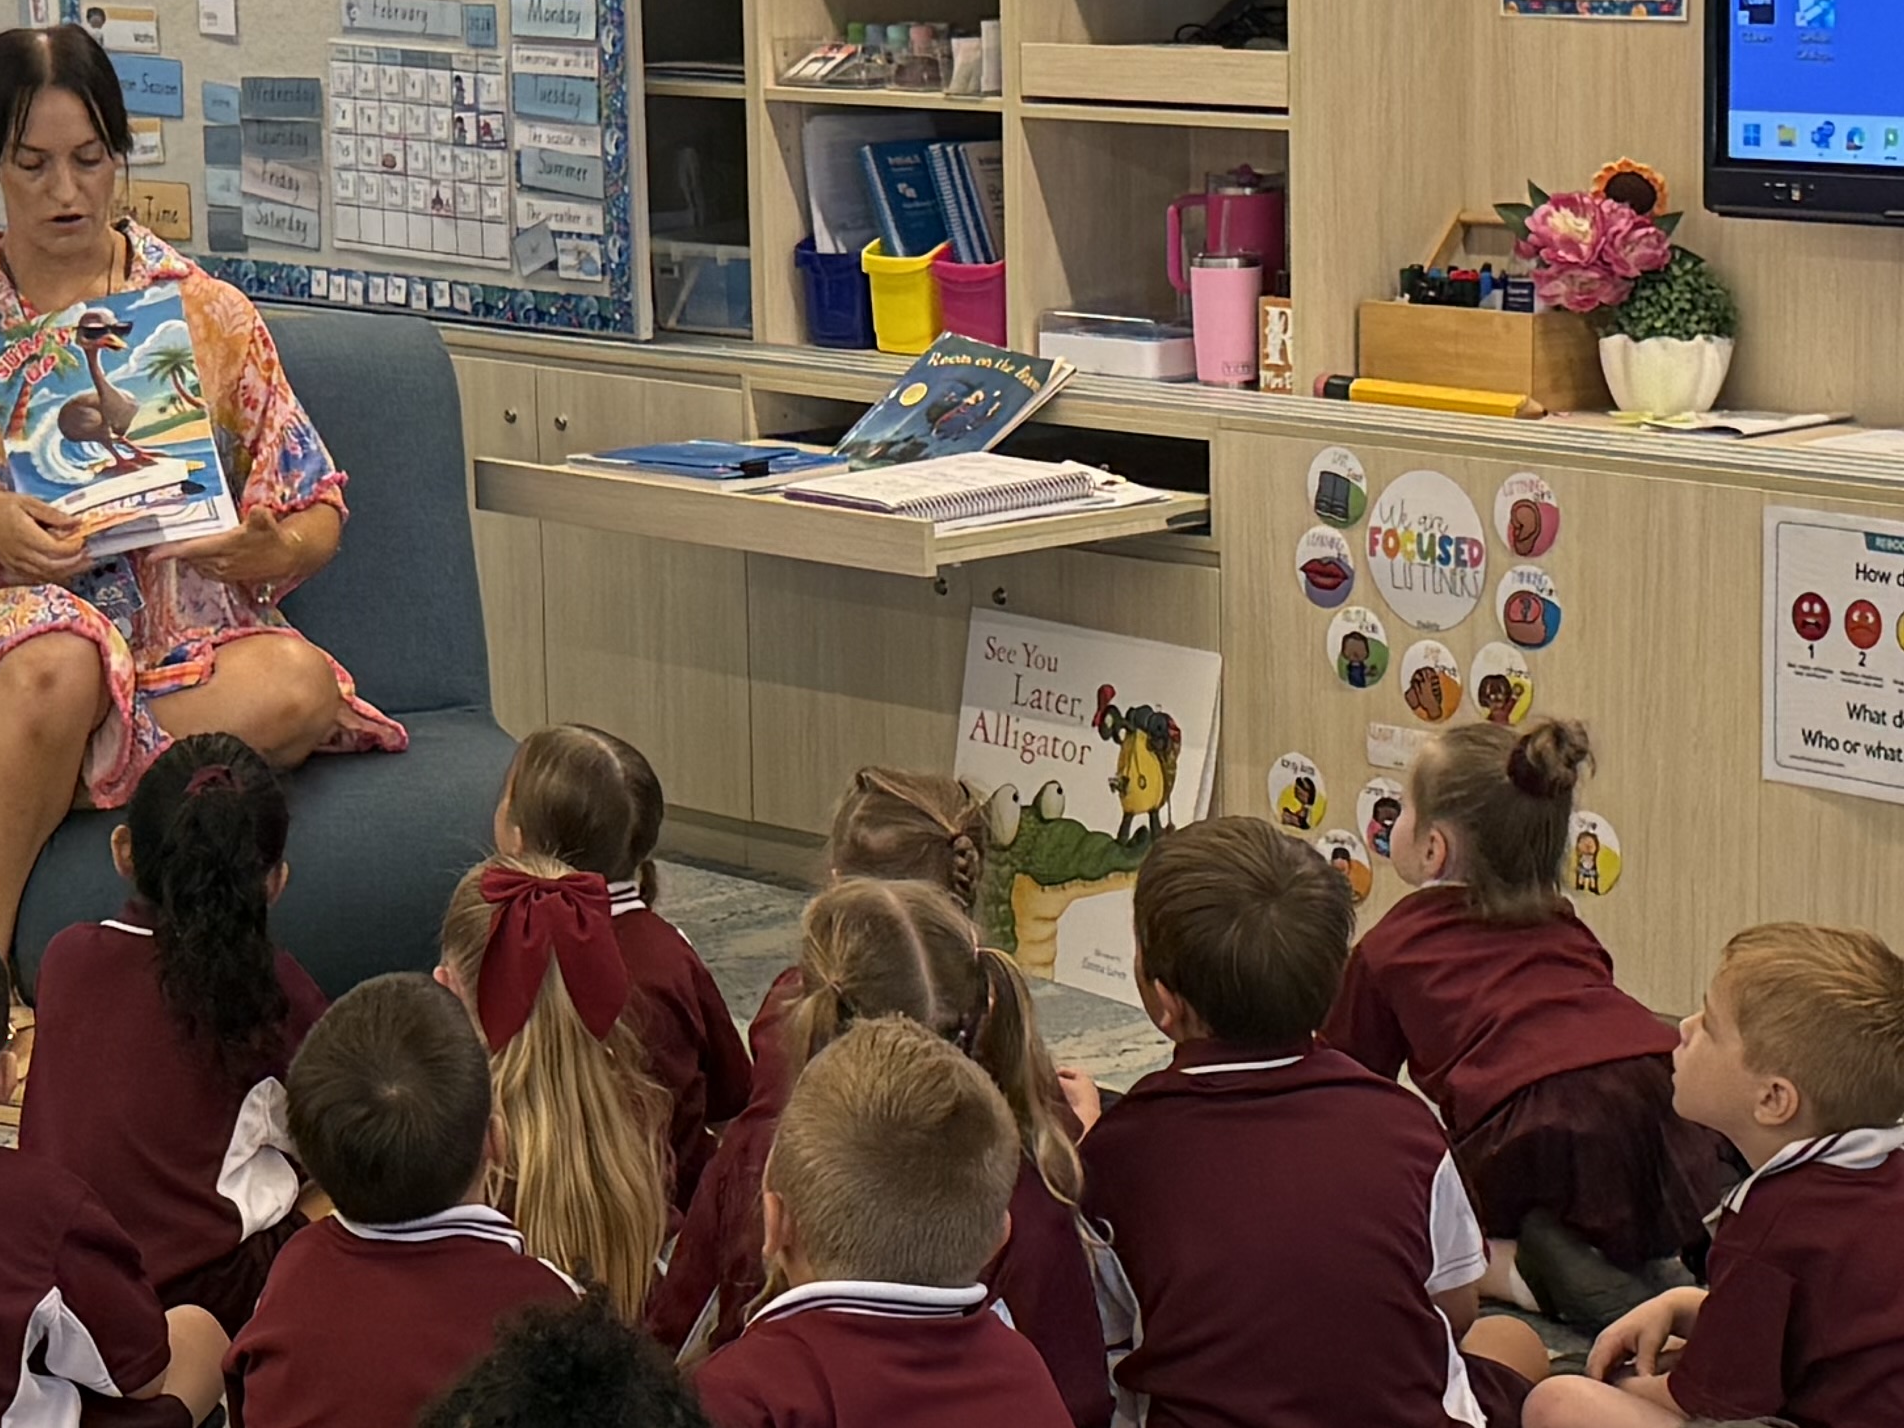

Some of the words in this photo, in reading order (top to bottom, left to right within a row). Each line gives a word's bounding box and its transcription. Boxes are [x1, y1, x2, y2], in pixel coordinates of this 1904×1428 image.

[534, 75, 582, 119] Tuesday
[537, 149, 588, 183] Summer
[144, 195, 179, 224] Time
[255, 201, 308, 242] Saturday
[24, 353, 59, 385] UP
[928, 351, 972, 368] Room
[975, 356, 993, 369] on
[995, 357, 1016, 374] the
[1368, 525, 1484, 568] FOCUSED
[1855, 562, 1892, 586] How
[984, 635, 1019, 663] See
[1020, 641, 1060, 674] You
[1808, 643, 1815, 659] 1
[1858, 650, 1867, 667] 2
[1011, 673, 1086, 724] Later,
[1846, 701, 1887, 726] What
[968, 710, 1093, 767] Alligator
[1801, 728, 1840, 753] Who
[1843, 739, 1861, 754] or
[1864, 742, 1903, 764] what
